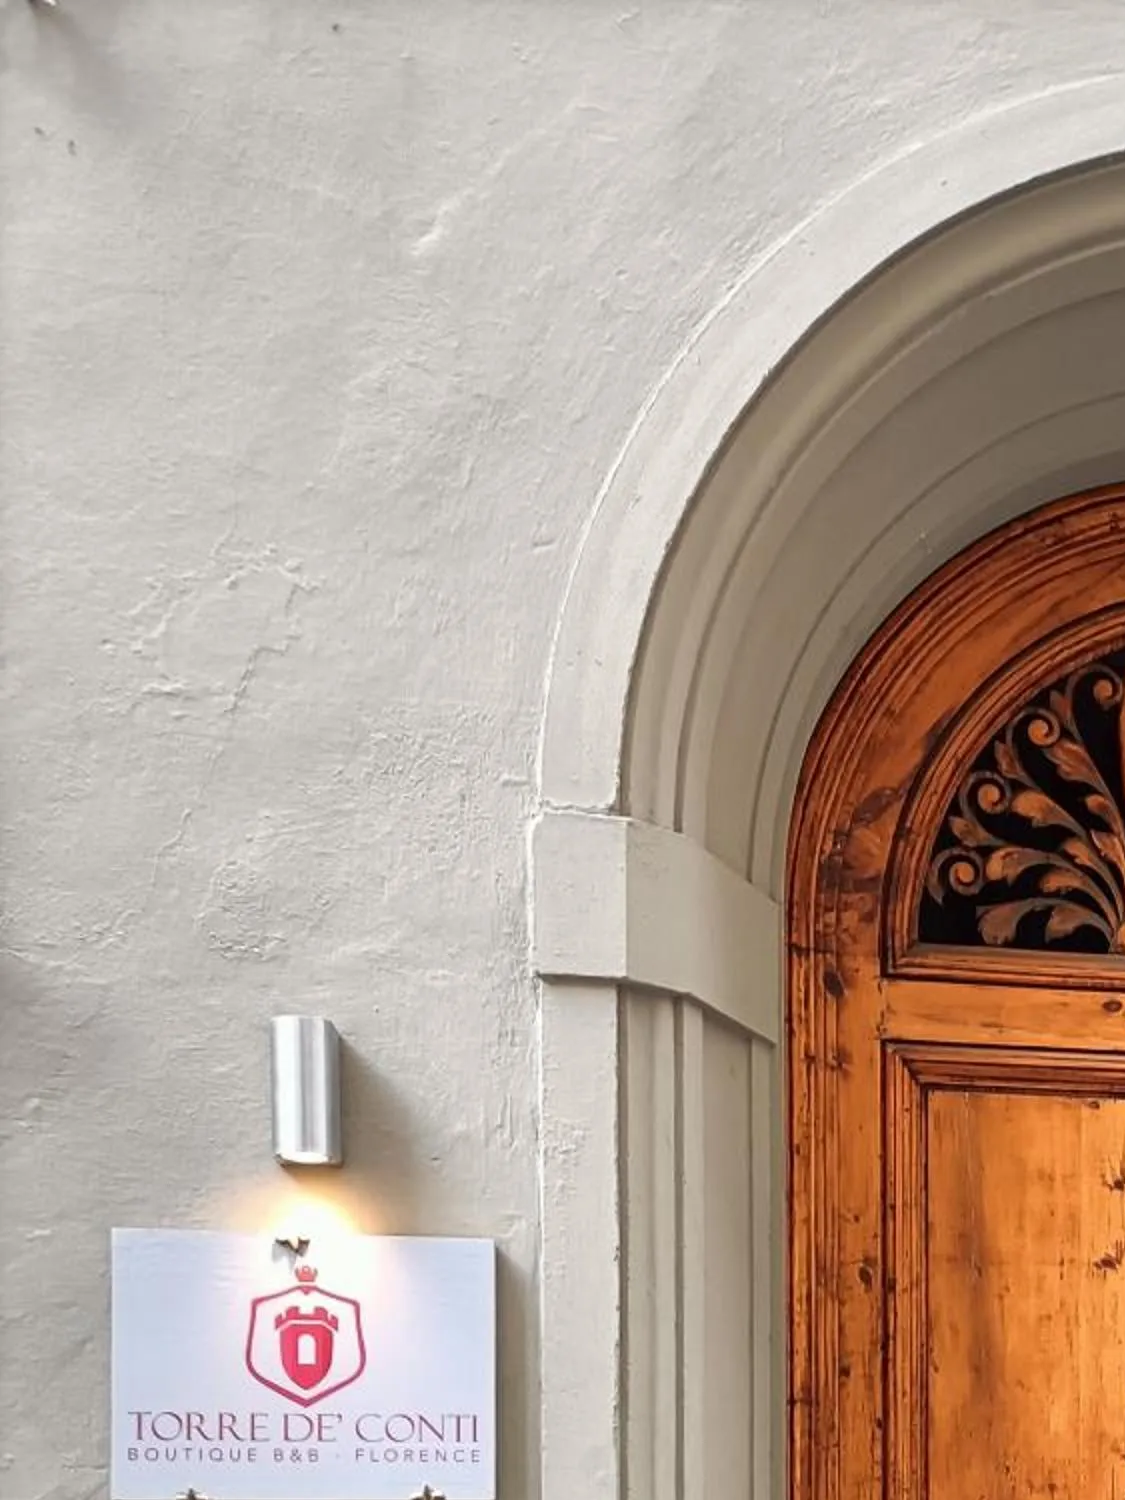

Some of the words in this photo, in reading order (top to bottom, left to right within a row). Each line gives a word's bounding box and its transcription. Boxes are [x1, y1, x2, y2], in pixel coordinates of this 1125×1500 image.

[127, 1411, 271, 1442] TORRE
[355, 1413, 478, 1443] CONTI
[127, 1447, 257, 1462] BOUTIQUE
[273, 1448, 319, 1462] B&B
[355, 1448, 481, 1463] FLORENCE
